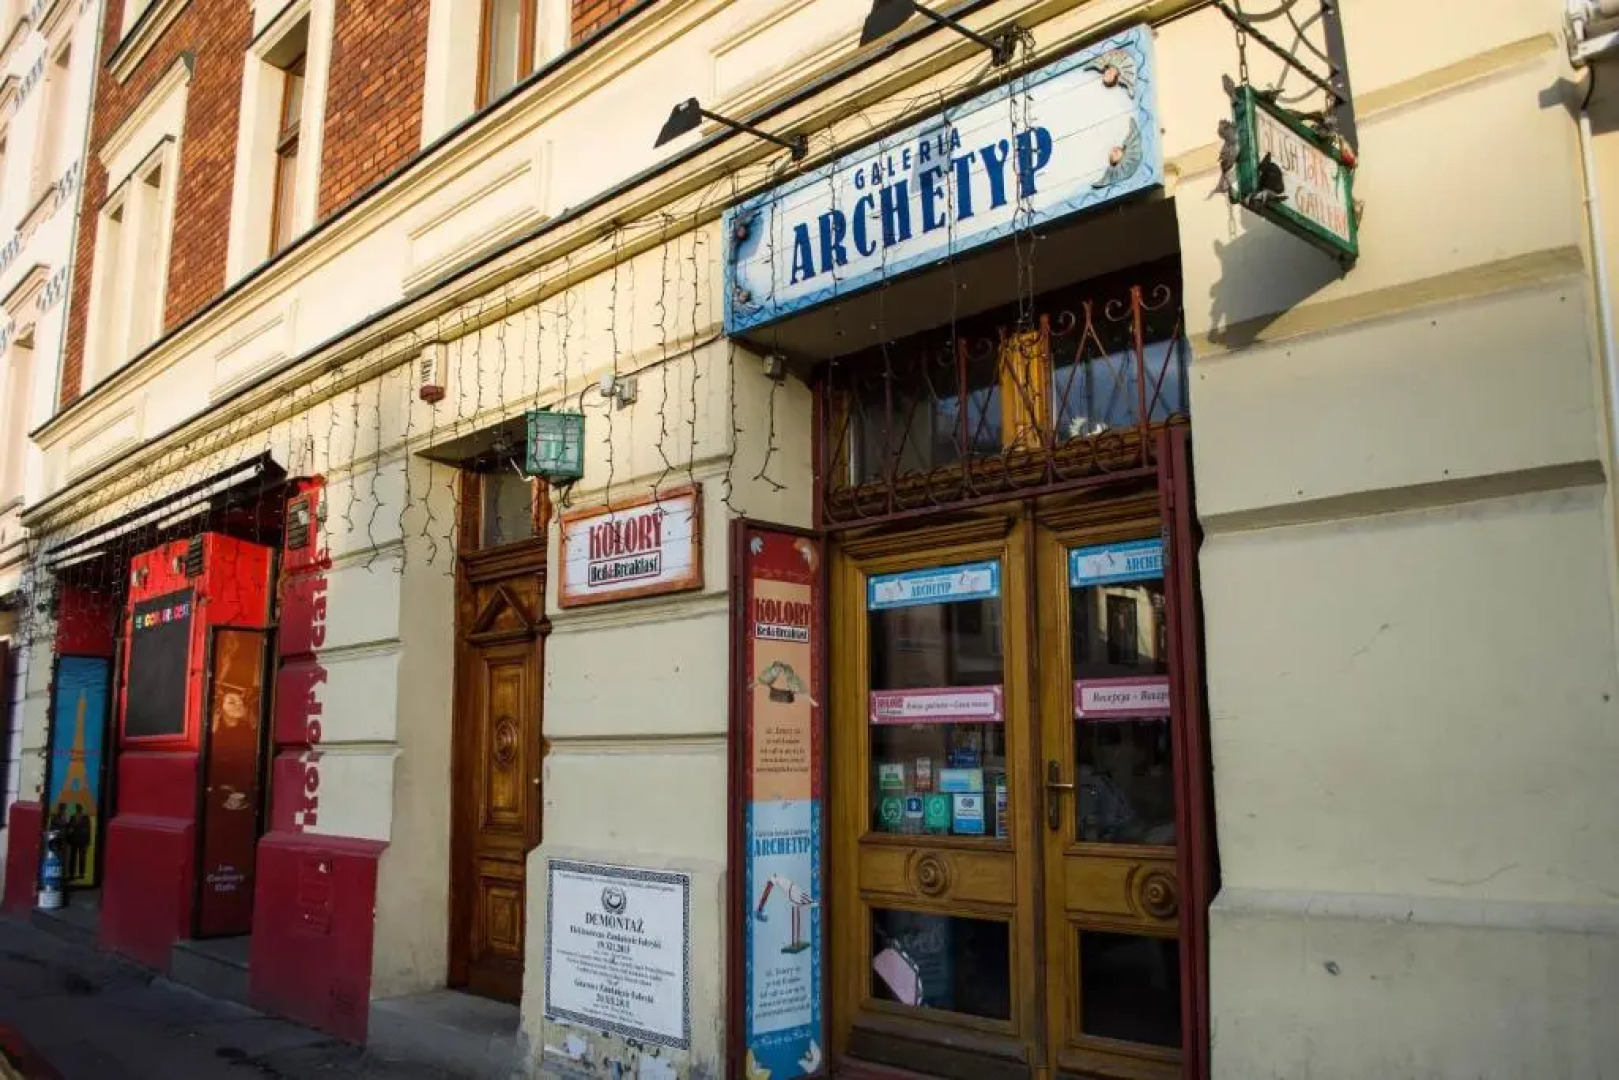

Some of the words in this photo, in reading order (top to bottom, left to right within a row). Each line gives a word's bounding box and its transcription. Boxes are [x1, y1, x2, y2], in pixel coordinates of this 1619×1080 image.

[854, 127, 963, 191] GALERIA
[790, 126, 1053, 286] ARCHETYP
[589, 512, 662, 560] KOLORY
[754, 598, 811, 626] KOLORY
[753, 836, 812, 857] ARCHETYP
[585, 911, 645, 934] DEMONTAŻ
